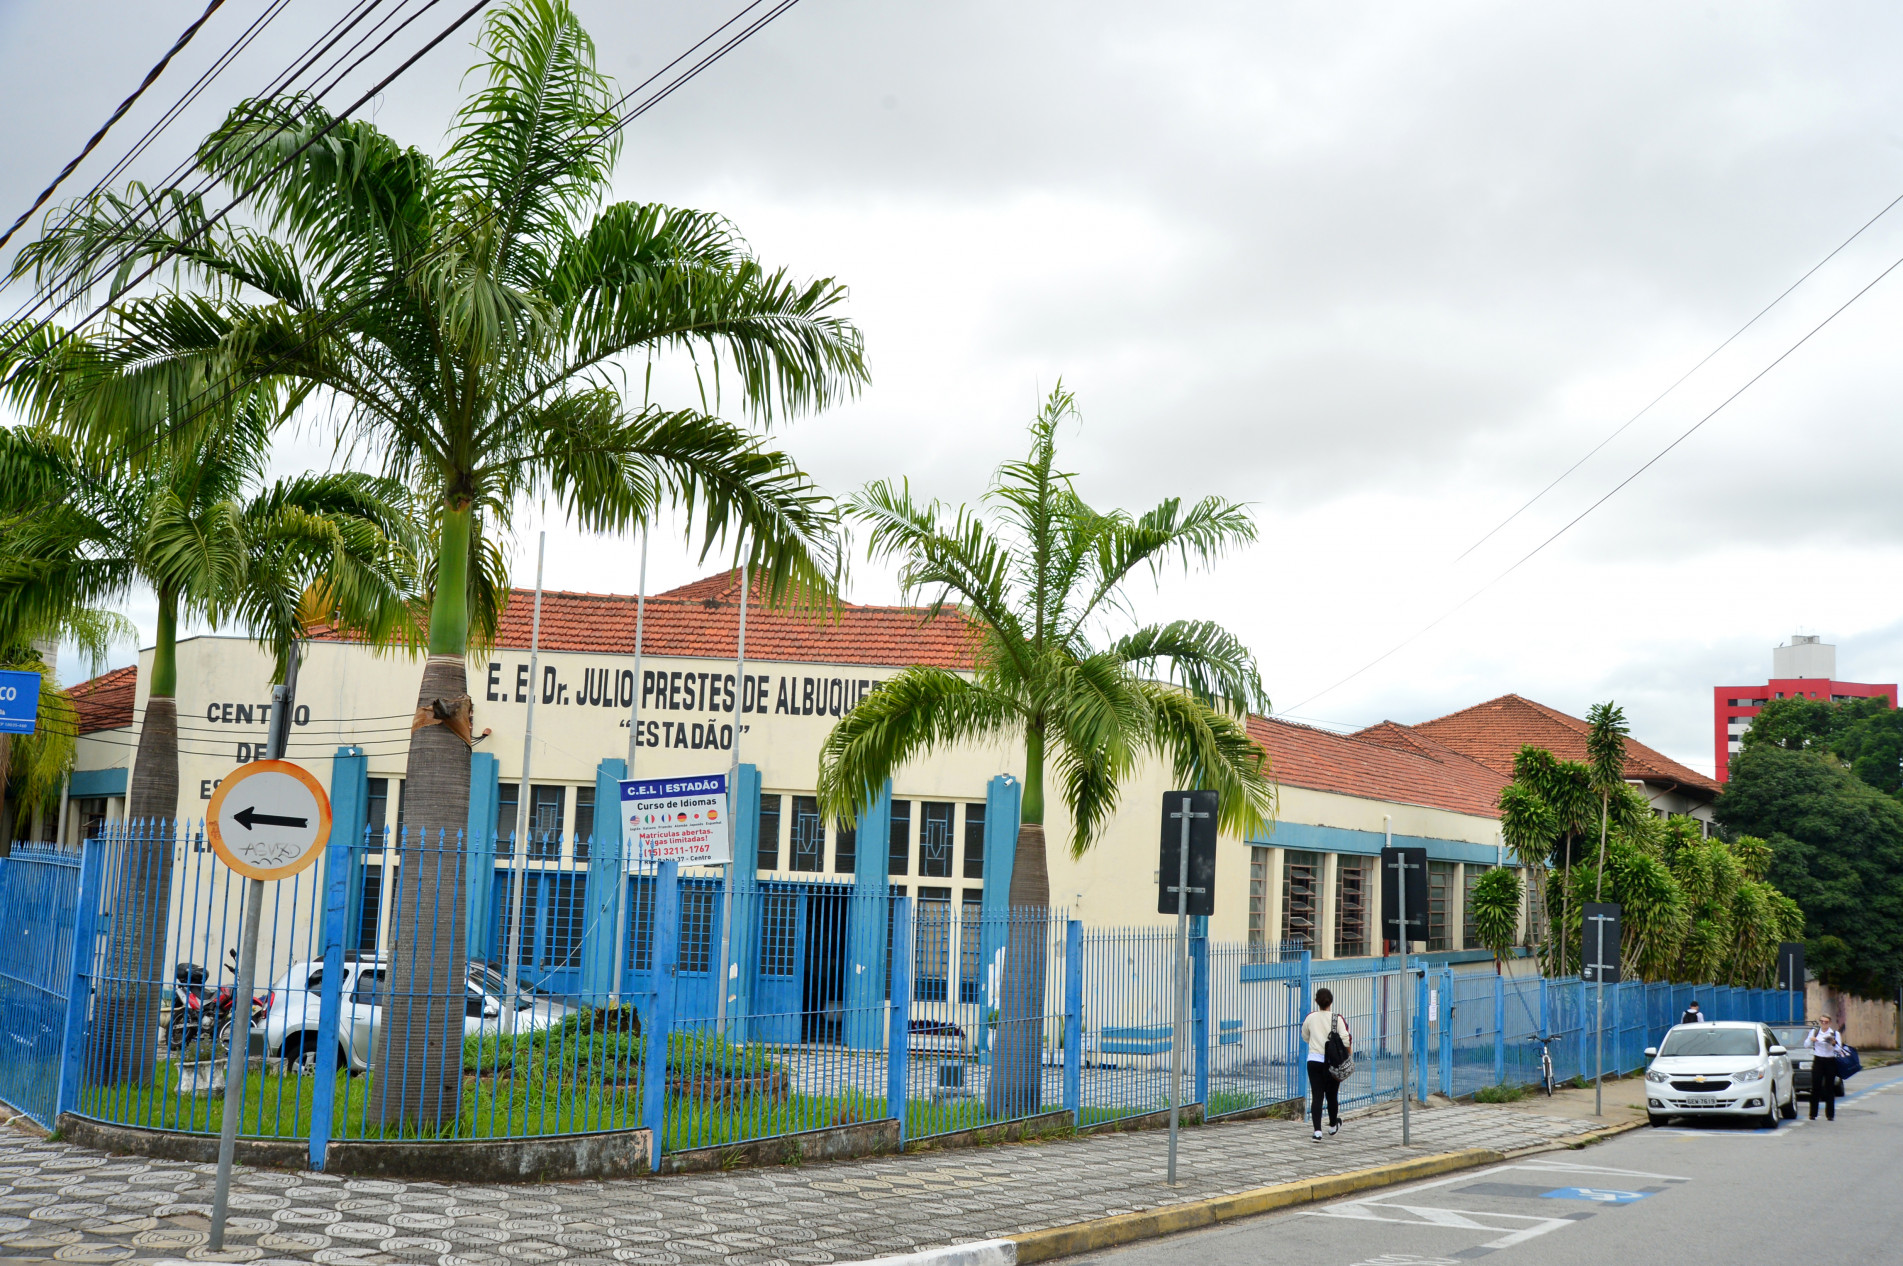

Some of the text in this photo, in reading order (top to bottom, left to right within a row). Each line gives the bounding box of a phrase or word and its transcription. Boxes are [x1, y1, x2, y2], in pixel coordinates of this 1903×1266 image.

[487, 662, 508, 702] E.
[542, 666, 569, 706] Dr.
[576, 667, 634, 708] JULIO
[642, 670, 736, 713] PRESTES
[742, 674, 770, 714] DE
[207, 702, 310, 726] CENTO
[627, 786, 656, 796] C.E.L
[666, 780, 719, 793] ESTADÃO
[637, 798, 717, 811] Curso de Idiomas
[670, 835, 708, 844] limitadas!
[664, 844, 710, 856] 3211-1767
